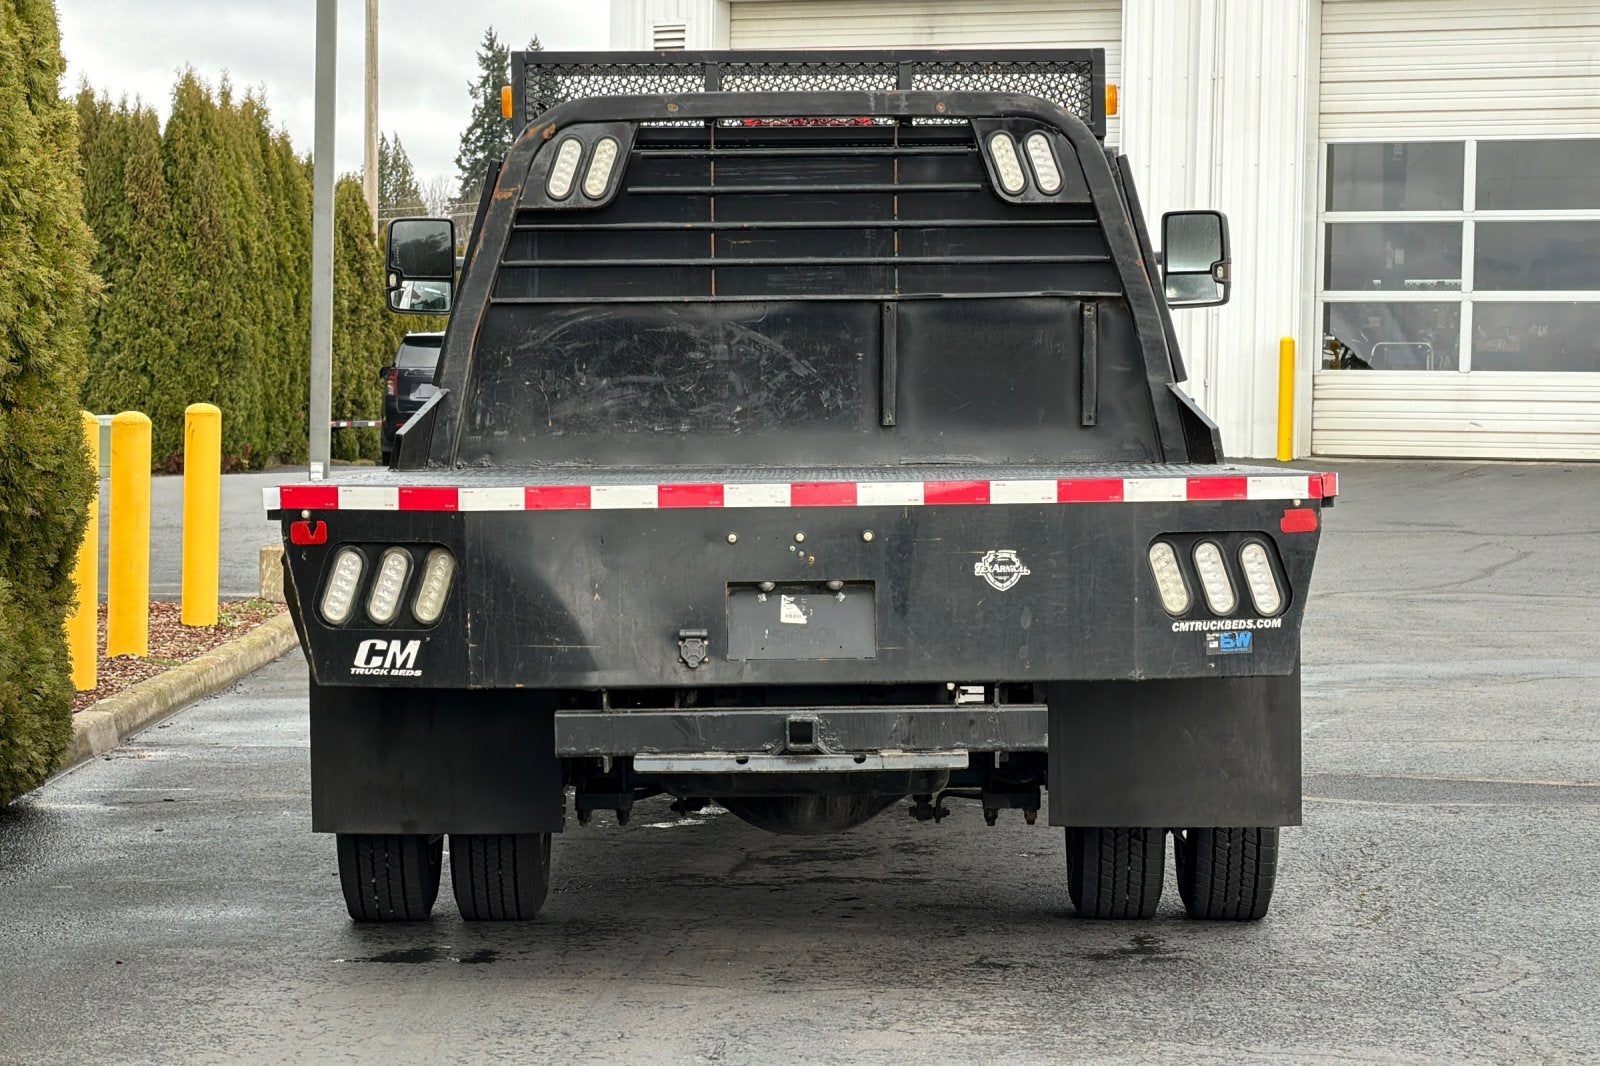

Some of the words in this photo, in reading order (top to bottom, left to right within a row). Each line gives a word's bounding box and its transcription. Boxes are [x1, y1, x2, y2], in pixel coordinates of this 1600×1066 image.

[1172, 618, 1282, 632] CMTRUCKBEDS.COM
[353, 638, 421, 669] CM
[350, 667, 389, 676] TRUCK
[390, 669, 423, 677] BEDS
